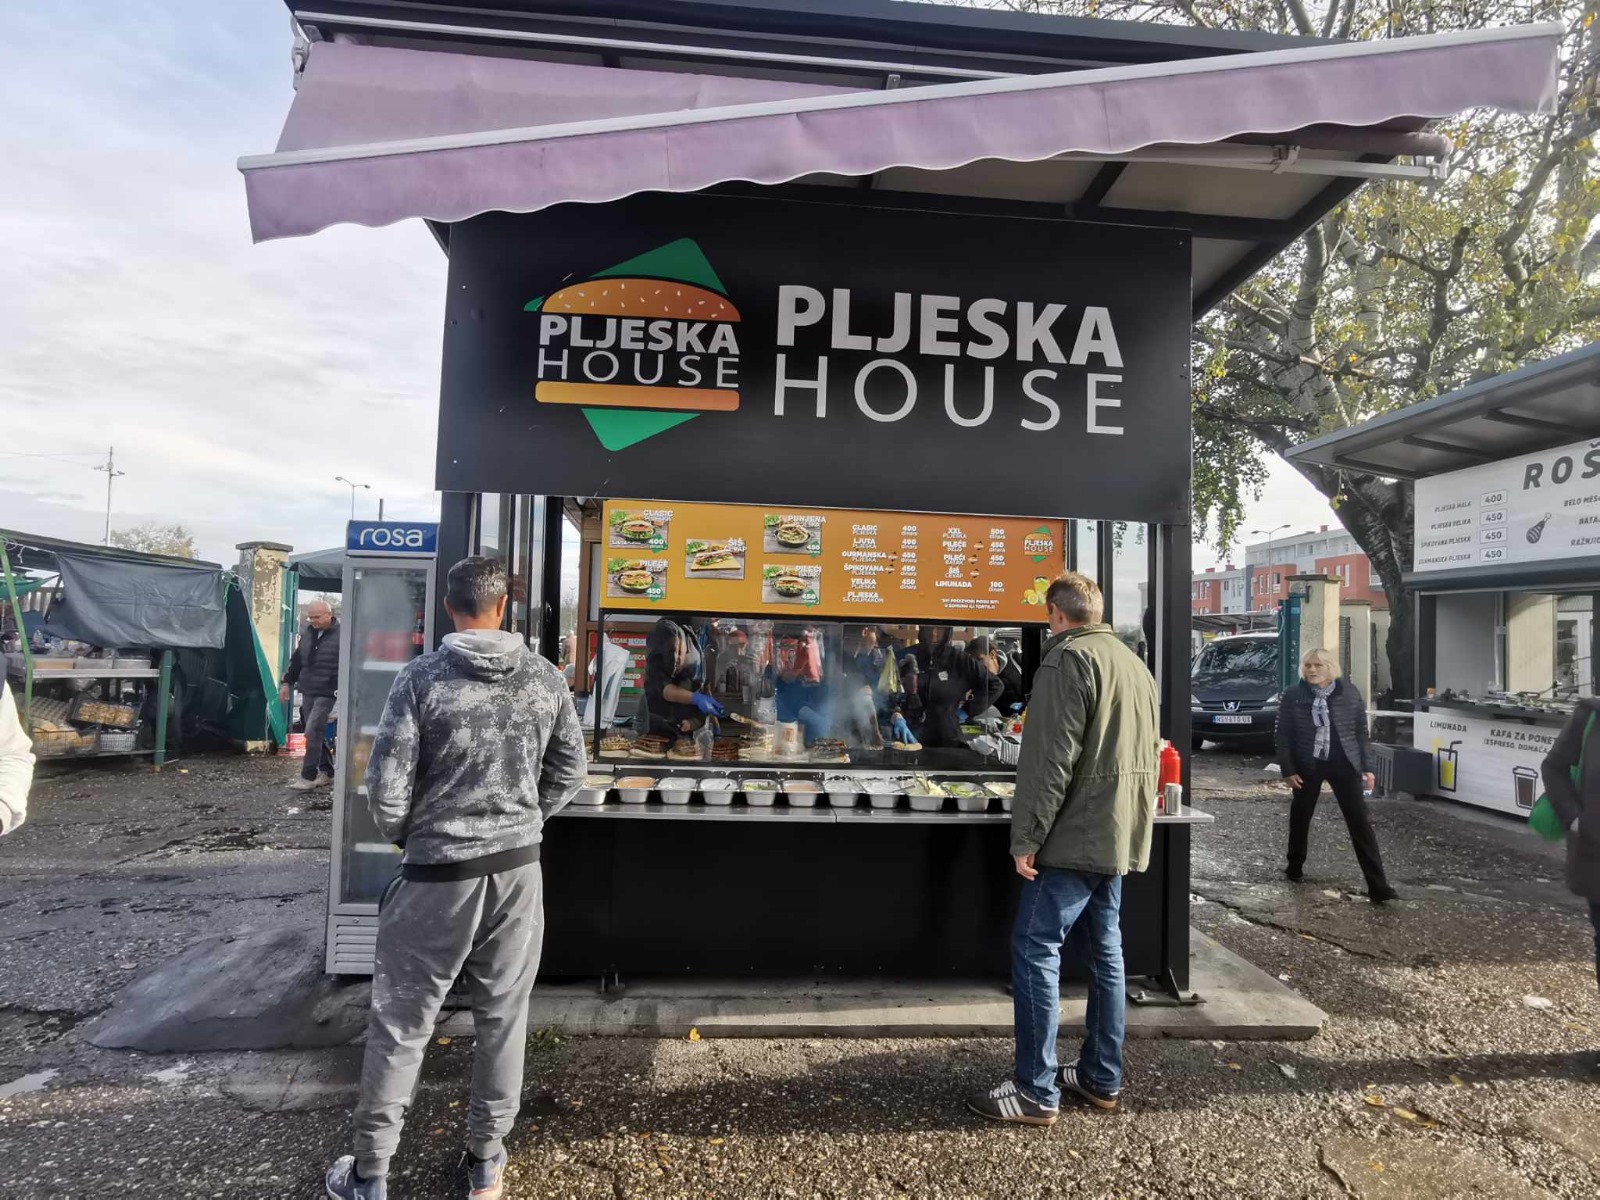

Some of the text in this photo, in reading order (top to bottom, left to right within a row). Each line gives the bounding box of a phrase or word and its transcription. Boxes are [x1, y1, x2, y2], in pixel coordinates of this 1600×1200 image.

[776, 284, 1124, 367] PLJESKA
[538, 314, 740, 354] PLJESKA
[536, 348, 740, 388] HOUSE
[773, 353, 1124, 435] HOUSE
[1485, 494, 1502, 502] 400
[1564, 498, 1582, 507] BELO
[789, 515, 826, 523] PUNJENA
[1486, 512, 1502, 521] 450
[1579, 516, 1600, 525] BATA
[360, 528, 422, 547] rosa
[1485, 531, 1502, 540] 450
[1430, 721, 1467, 732] LIMUNADA
[1490, 729, 1512, 738] KAFA
[1514, 732, 1526, 740] ZA
